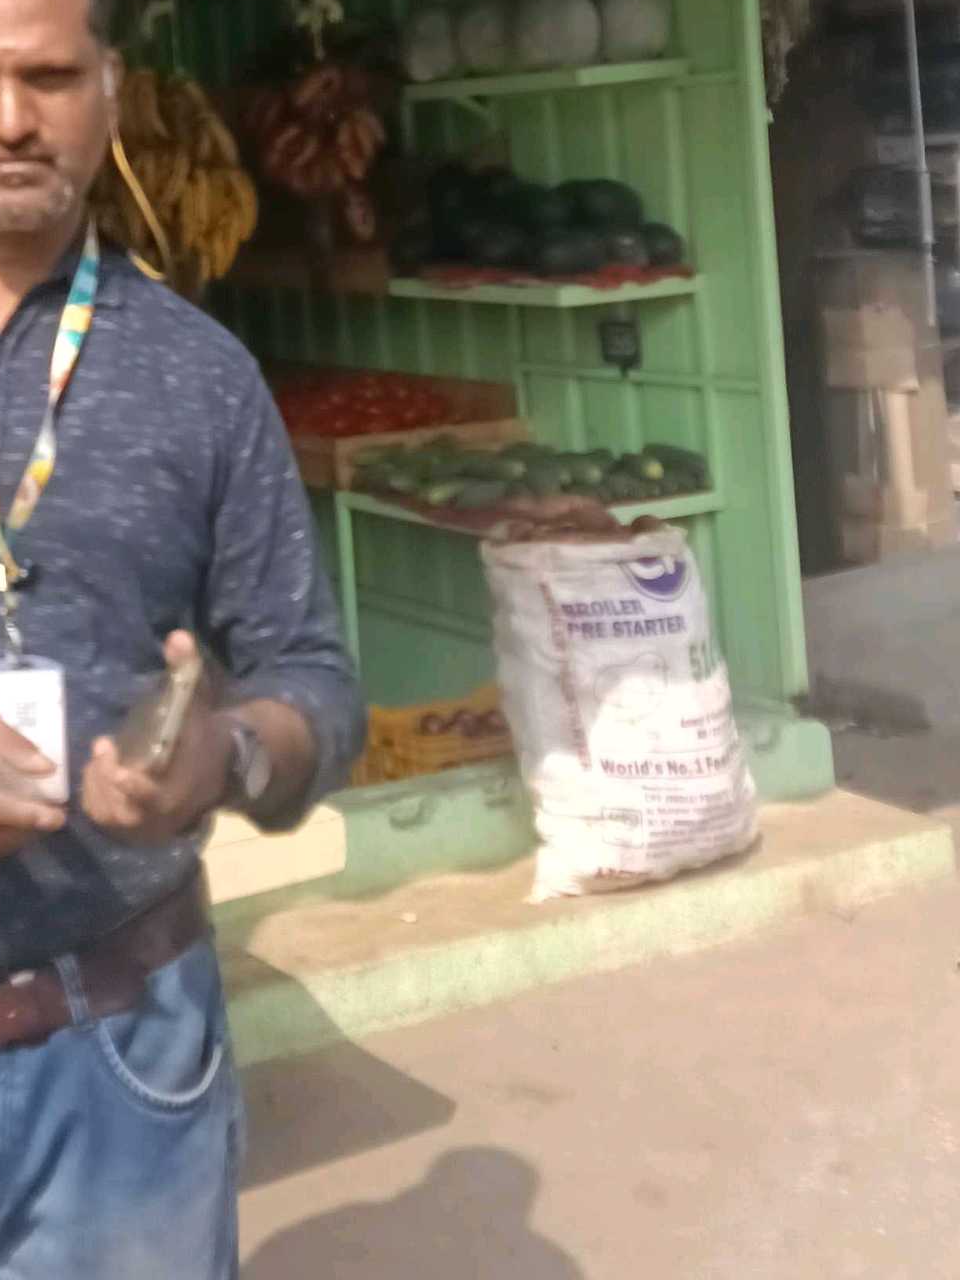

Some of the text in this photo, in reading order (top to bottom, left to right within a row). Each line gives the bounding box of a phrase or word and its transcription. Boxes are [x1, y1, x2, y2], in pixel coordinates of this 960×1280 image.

[561, 599, 644, 618] BROILER
[567, 615, 686, 639] PRE STARTER
[600, 757, 663, 776] World's
